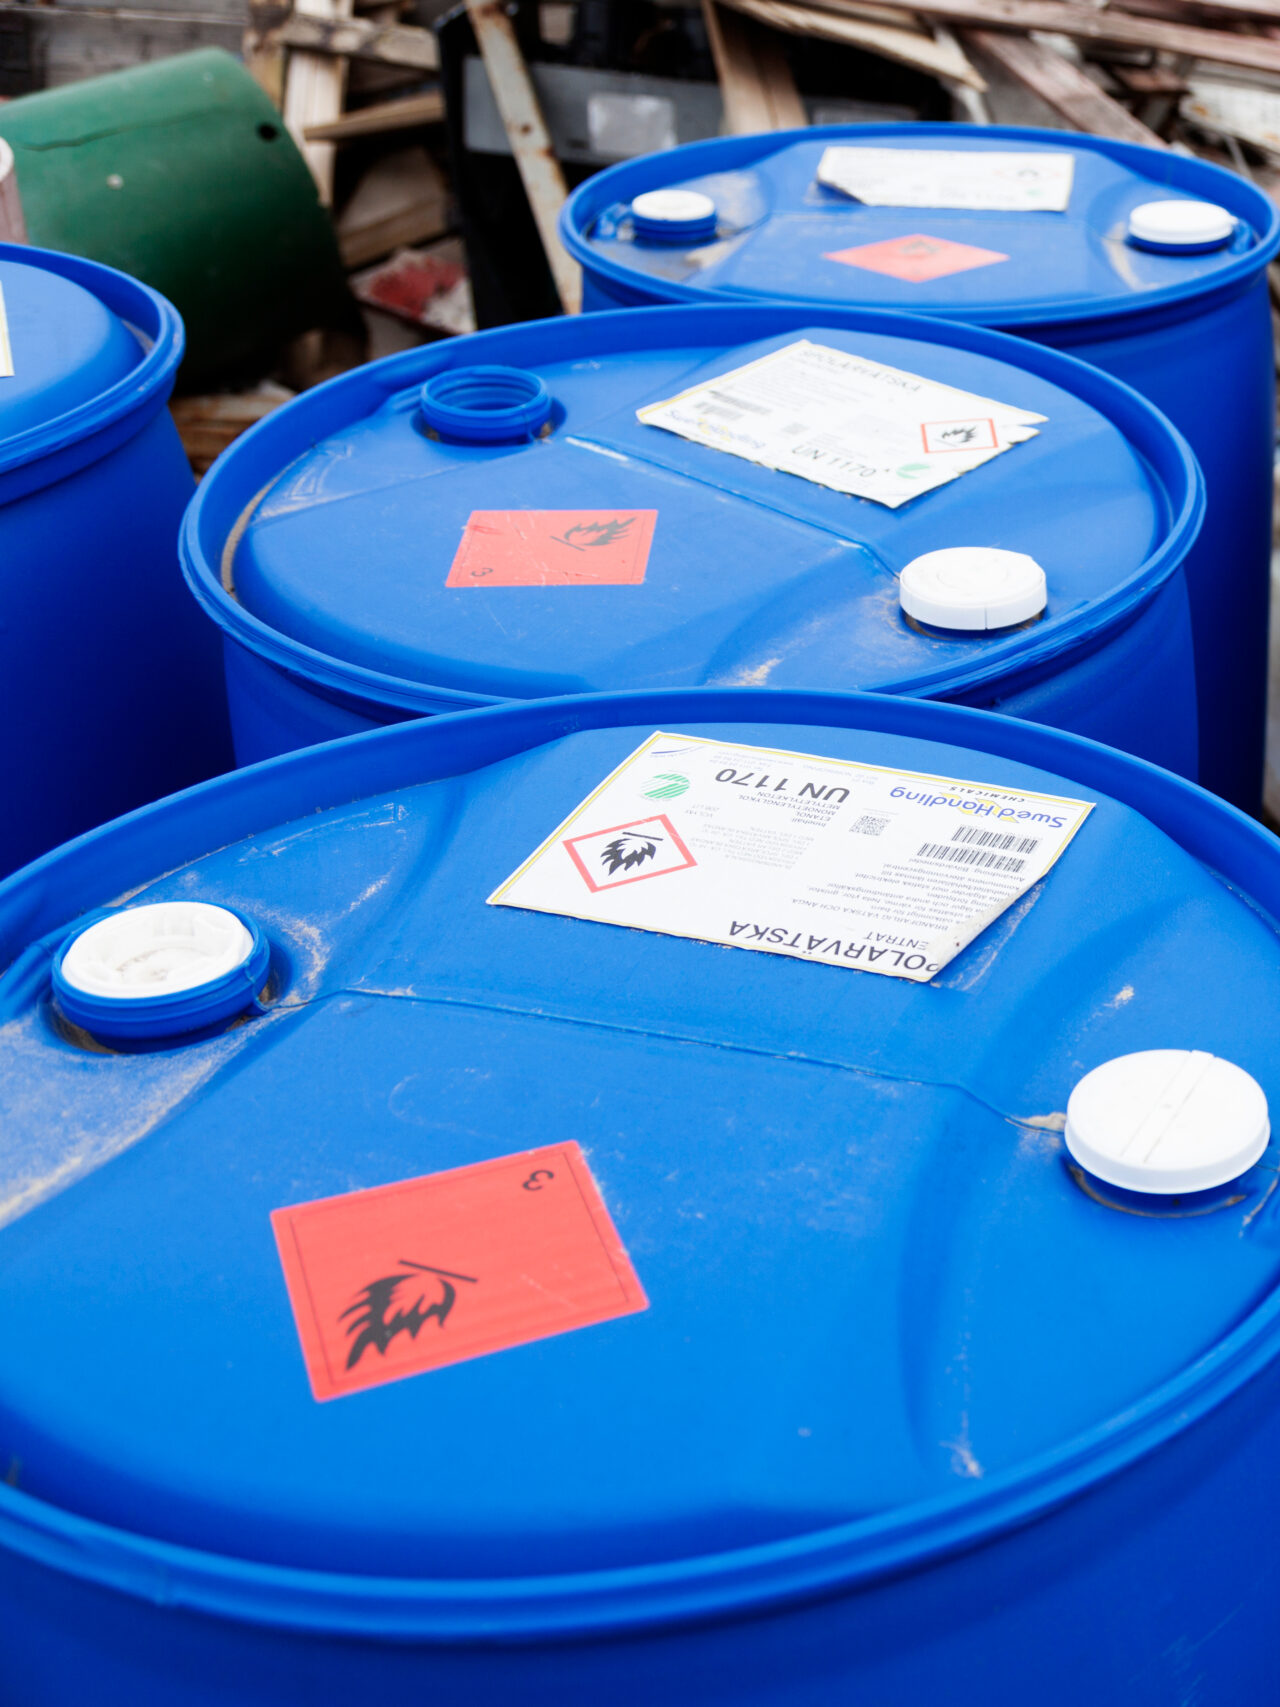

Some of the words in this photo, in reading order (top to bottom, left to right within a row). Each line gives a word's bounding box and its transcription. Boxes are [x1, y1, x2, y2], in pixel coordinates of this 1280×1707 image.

[716, 769, 788, 791] 1170
[798, 783, 849, 803] UN
[890, 787, 994, 816] Handling
[792, 811, 832, 821] ETANOL
[997, 809, 1066, 828] Swed
[521, 1169, 555, 1192] 3
